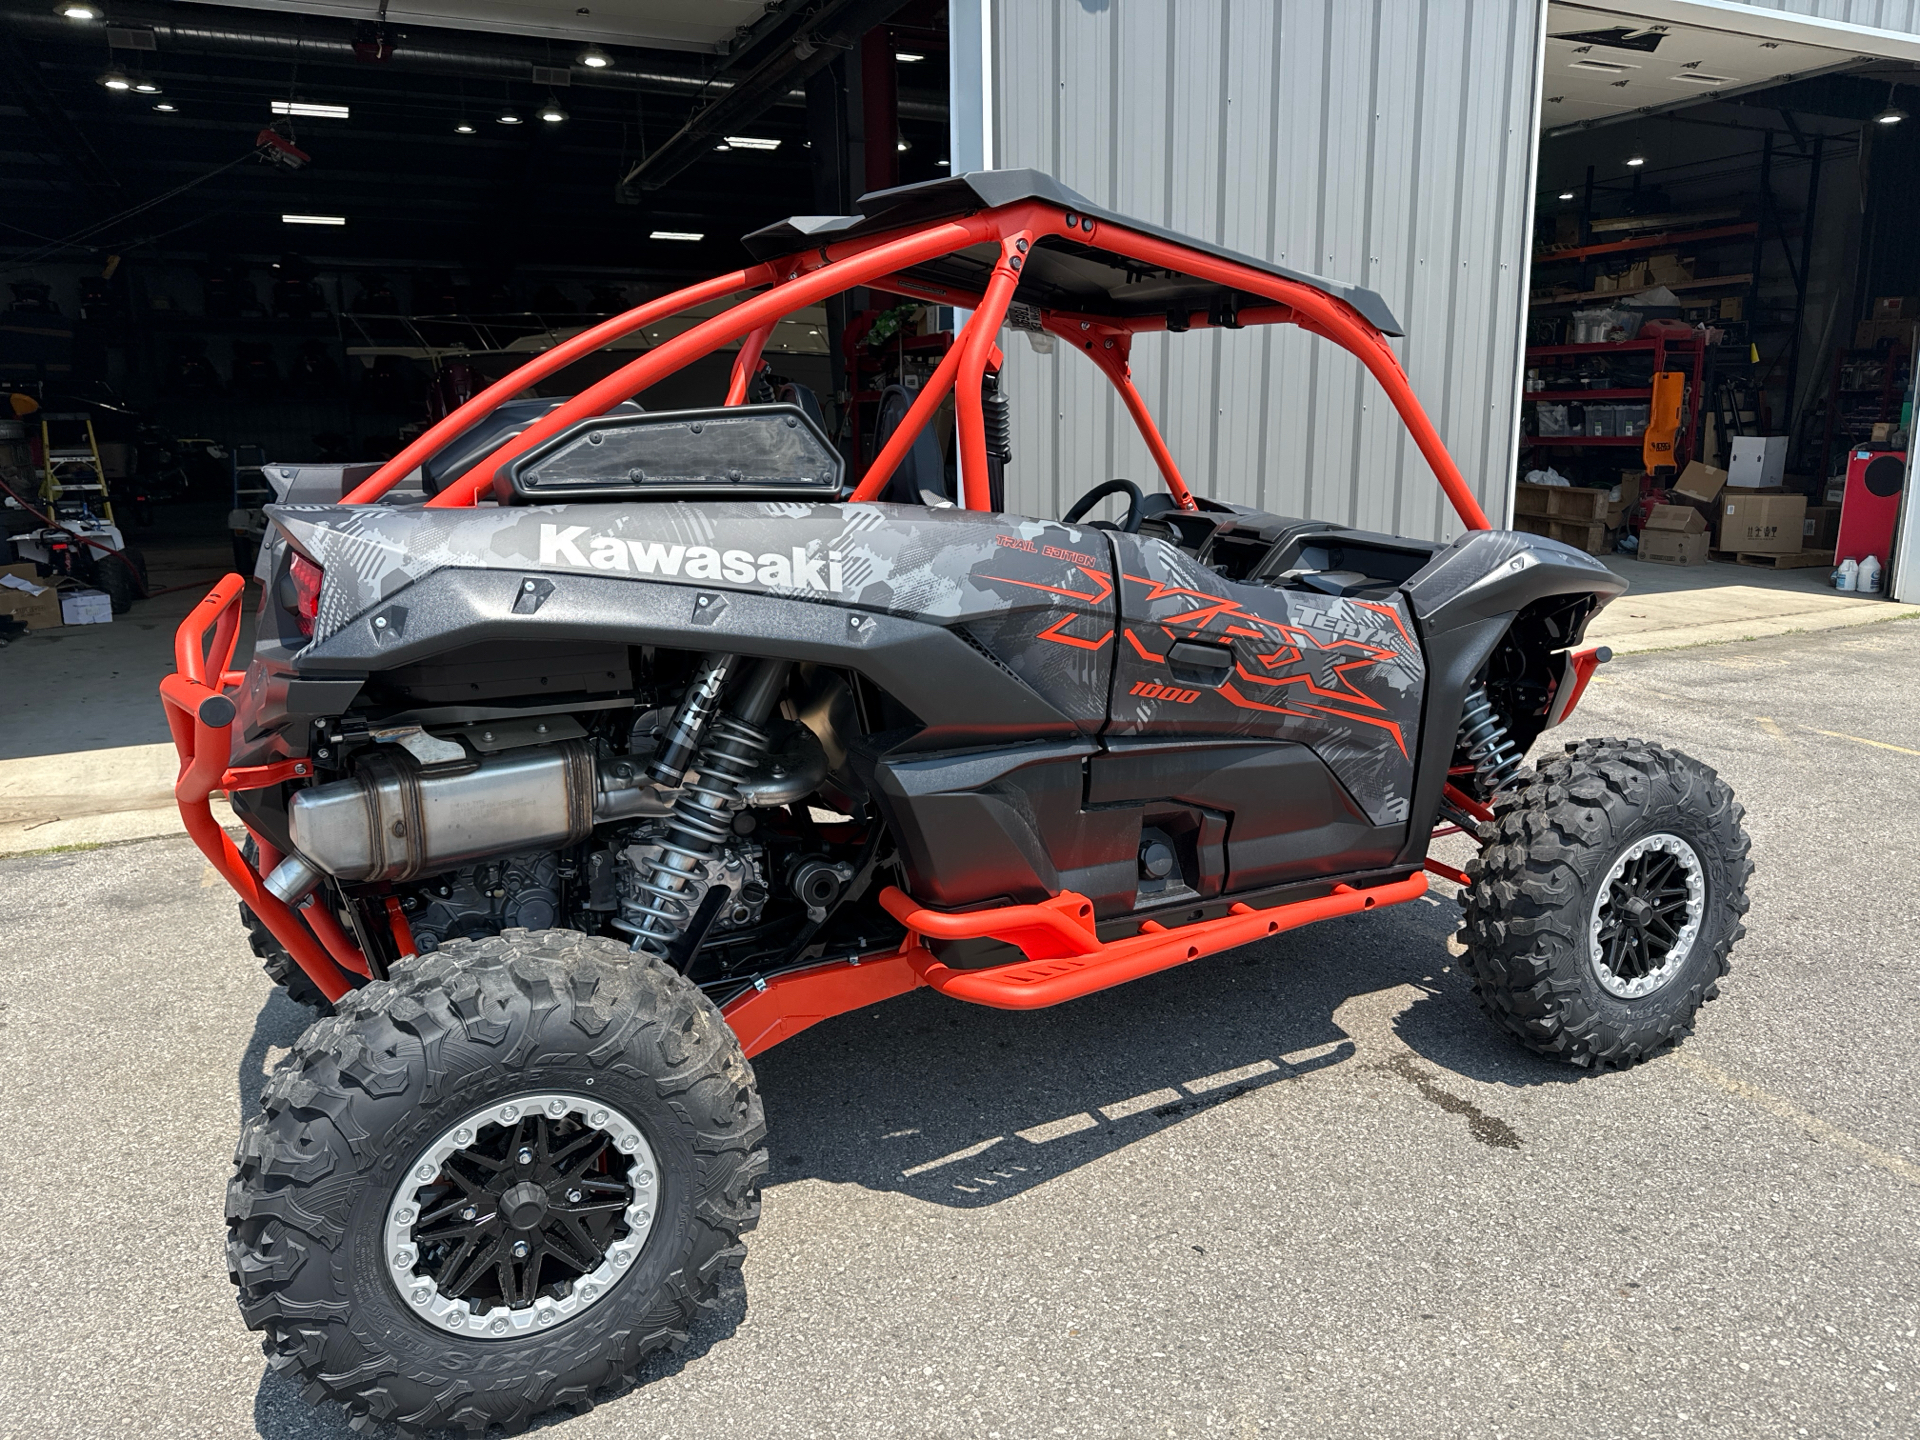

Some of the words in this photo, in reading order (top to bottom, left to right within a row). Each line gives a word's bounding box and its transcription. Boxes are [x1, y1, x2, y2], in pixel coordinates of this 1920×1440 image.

[540, 523, 843, 592] Kawasaki
[995, 534, 1039, 554] TRAIL
[1041, 544, 1097, 568] EDITION
[1295, 604, 1397, 645] TERYX
[1128, 680, 1202, 704] 1000
